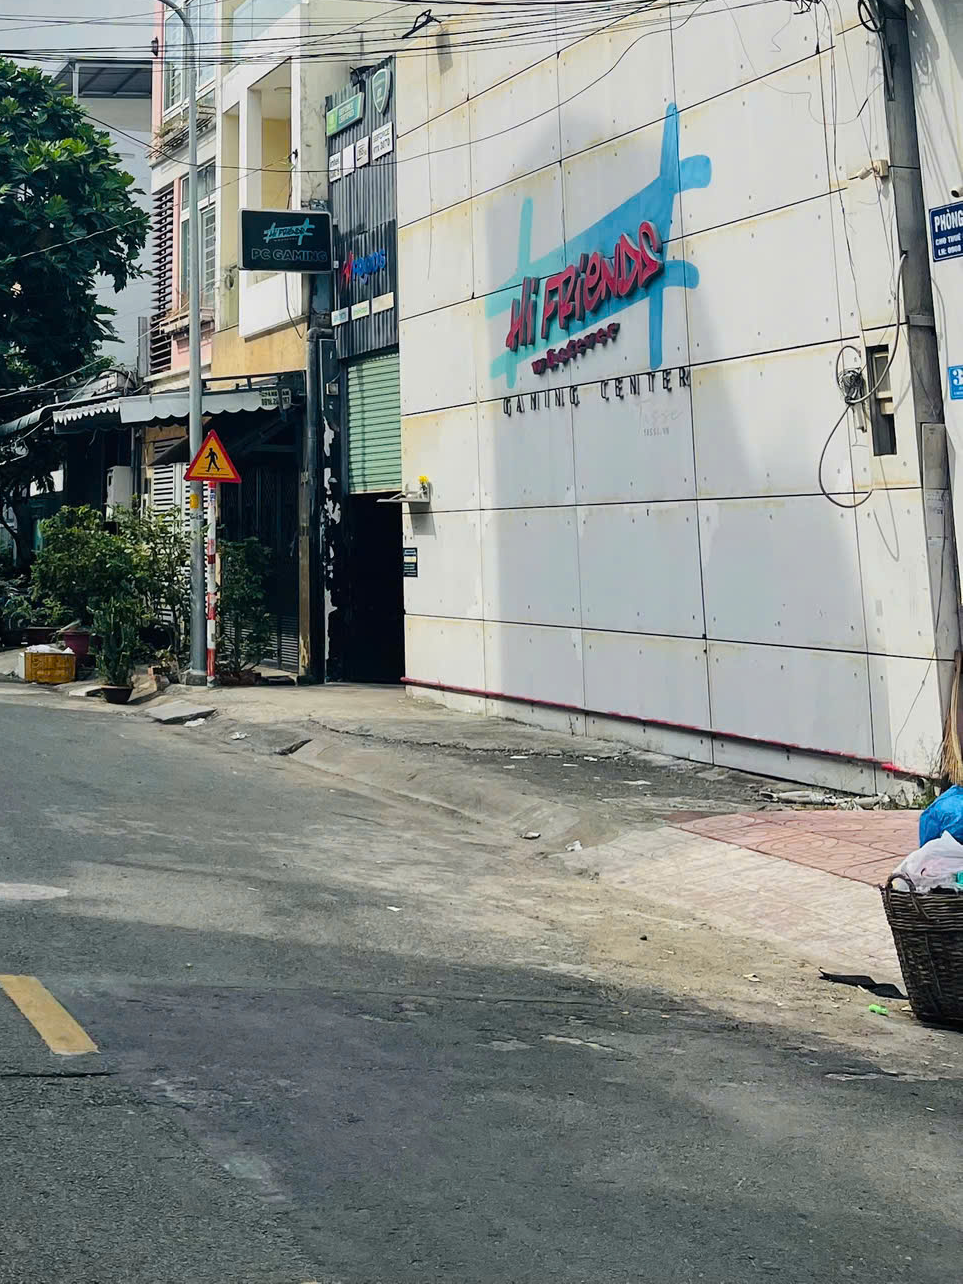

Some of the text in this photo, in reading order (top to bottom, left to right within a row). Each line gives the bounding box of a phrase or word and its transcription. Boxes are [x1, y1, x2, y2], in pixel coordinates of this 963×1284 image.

[251, 247, 328, 262] PC GAMING
[503, 367, 691, 417] GAMING CENTER
